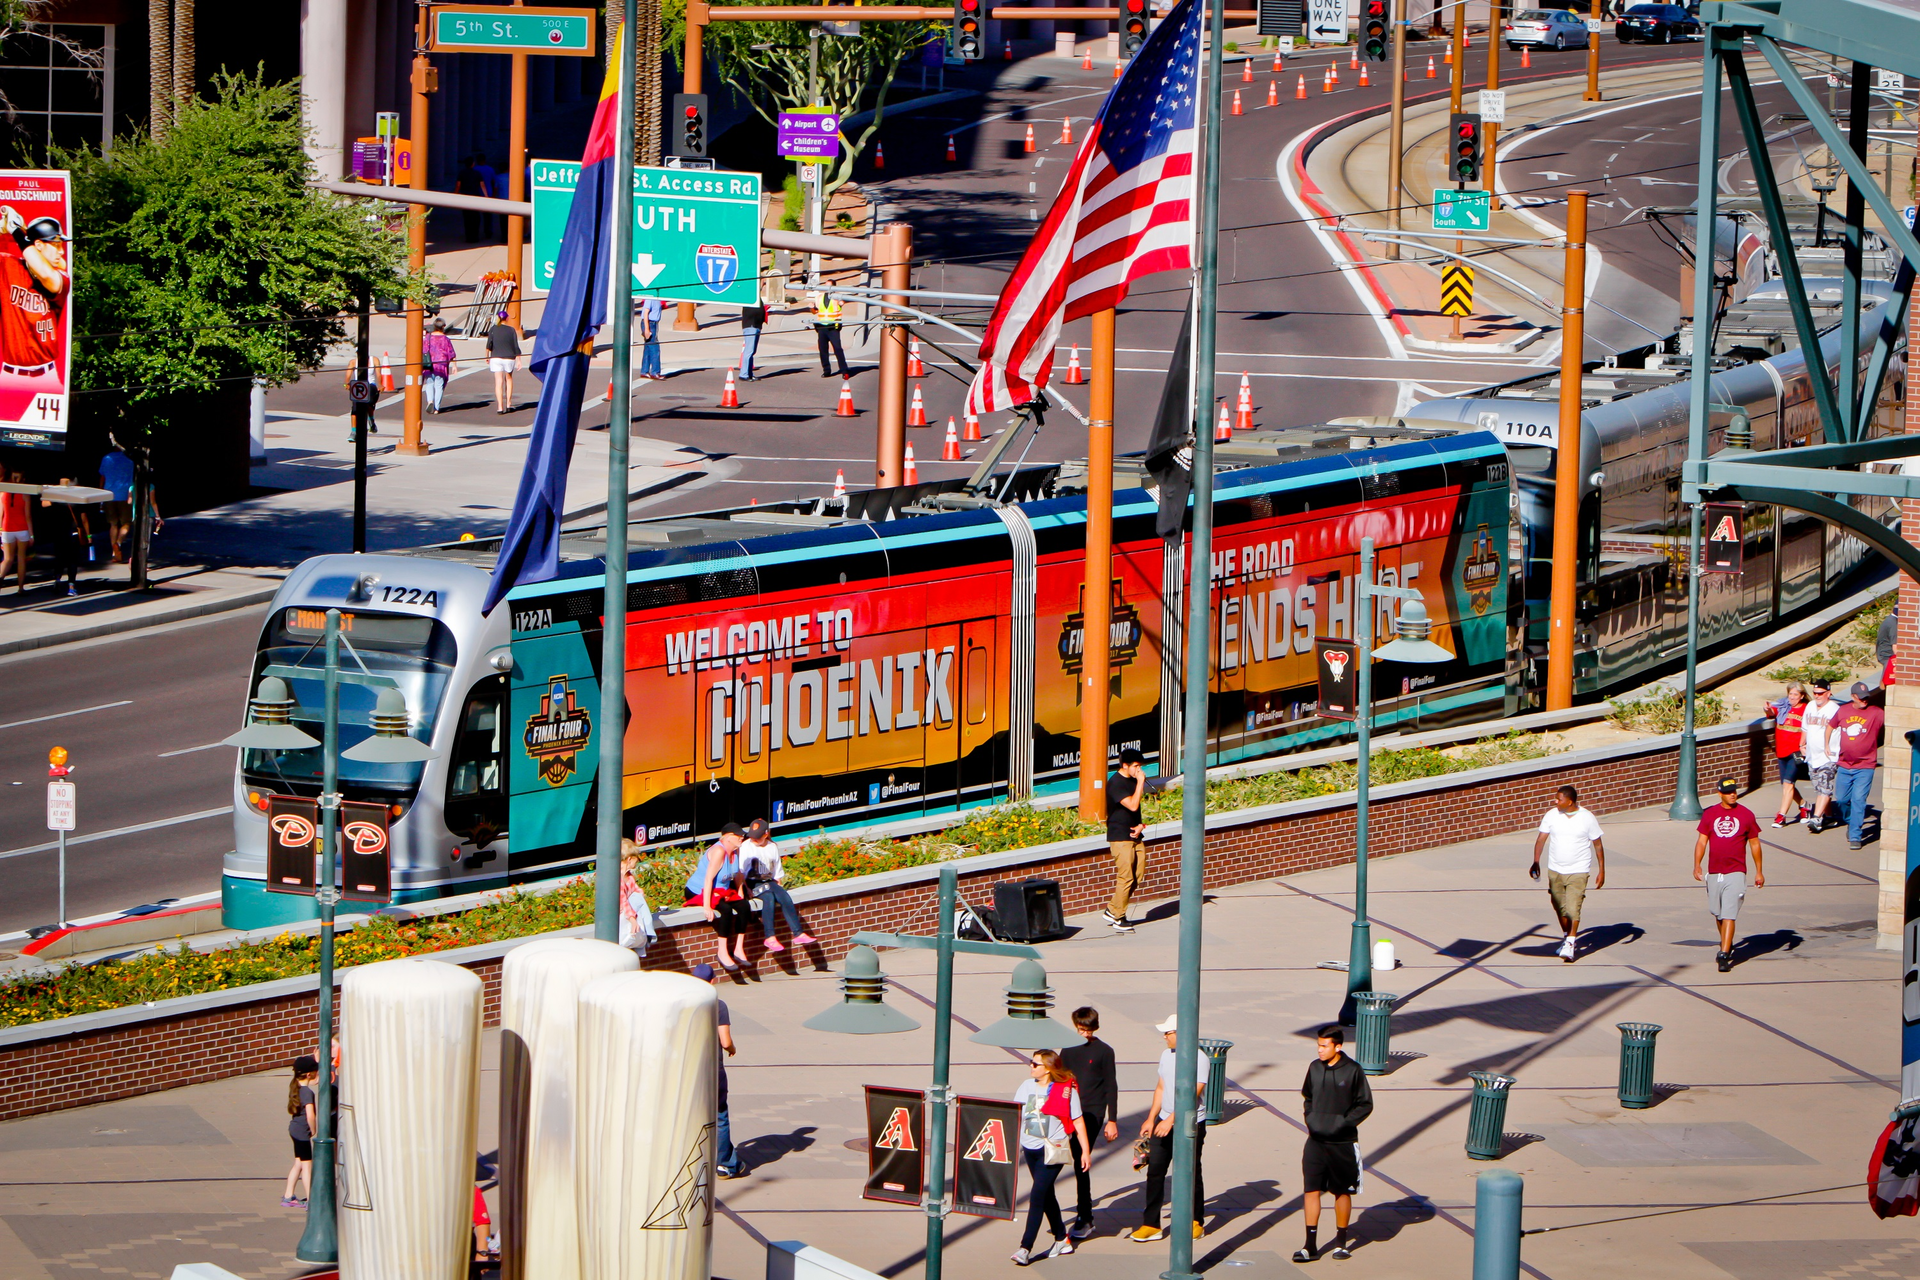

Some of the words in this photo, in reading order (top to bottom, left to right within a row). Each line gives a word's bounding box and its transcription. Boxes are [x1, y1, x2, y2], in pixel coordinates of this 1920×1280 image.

[1315, 0, 1342, 9] ONE
[542, 19, 562, 28] 500
[564, 20, 570, 28] E
[1313, 10, 1342, 22] WAY
[455, 20, 483, 36] 5th
[492, 21, 519, 38] St.
[1588, 21, 1600, 30] 30
[794, 120, 817, 130] Airport
[793, 137, 828, 146] Children's
[793, 145, 821, 153] Museum
[18, 180, 40, 188] PAUL
[658, 174, 724, 194] Access
[730, 178, 757, 196] Rd.
[0, 189, 63, 202] GOLDSCHMIDT
[1442, 192, 1451, 200] To
[1441, 206, 1451, 215] 17
[1435, 218, 1456, 226] South
[701, 246, 733, 256] INTERSTATE
[706, 258, 730, 286] 17
[36, 318, 56, 342] 44
[37, 397, 60, 422] 44
[9, 432, 46, 441] LEGENDS
[1506, 422, 1553, 439] 110A
[1487, 464, 1507, 483] 122B
[1211, 547, 1237, 590] HE
[1241, 538, 1295, 585] ROAD
[382, 585, 438, 608] 122A
[297, 610, 327, 629] MAIN
[516, 608, 552, 633] 122A
[1220, 583, 1317, 671] ENDS
[665, 613, 810, 676] WELCOME
[817, 608, 854, 652] TO
[1109, 621, 1131, 648] OUR
[1410, 674, 1436, 690] @FinalFour
[711, 645, 956, 762] PHOENIX
[532, 723, 557, 744] FINAL
[558, 719, 582, 740] FOUR
[56, 789, 66, 797] NO
[882, 781, 921, 799] @FinalFour
[50, 799, 73, 809] STOPPING
[786, 791, 858, 814] /FinalFourPhoenixAZ
[55, 817, 68, 825] TIME
[648, 821, 691, 840] @FinalFour
